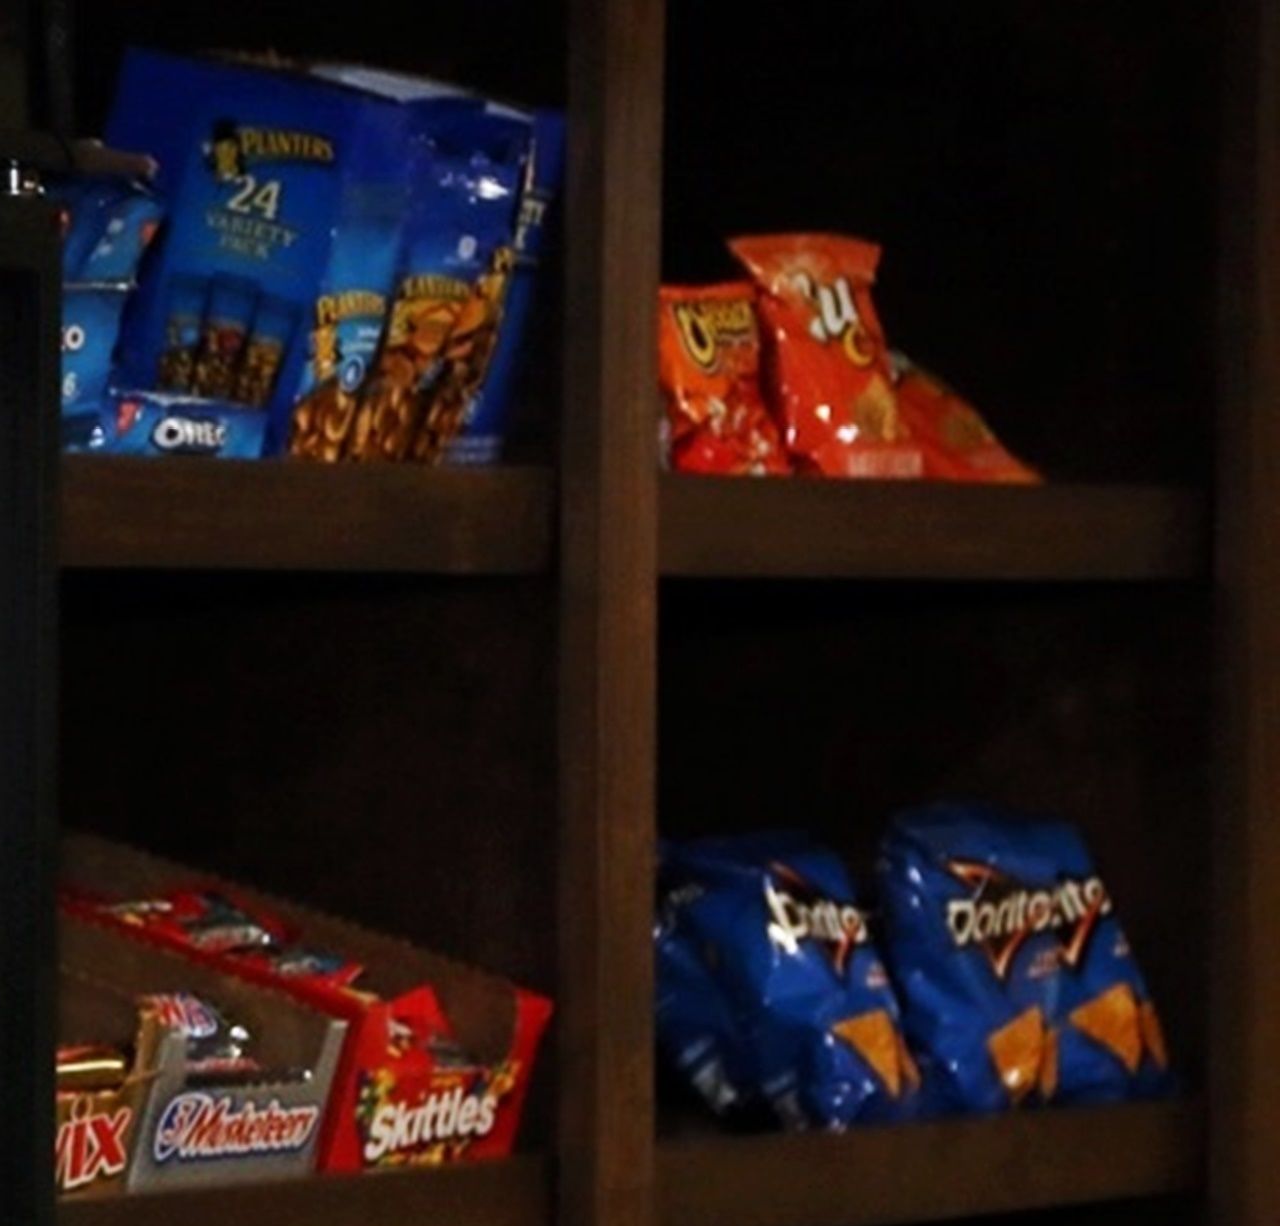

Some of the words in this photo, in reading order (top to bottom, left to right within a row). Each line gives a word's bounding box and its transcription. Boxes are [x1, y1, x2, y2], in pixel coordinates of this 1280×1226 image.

[238, 127, 335, 161] PLANTERS
[228, 173, 282, 219] 24
[205, 210, 299, 248] VARIETY
[363, 1086, 498, 1162] Skittles
